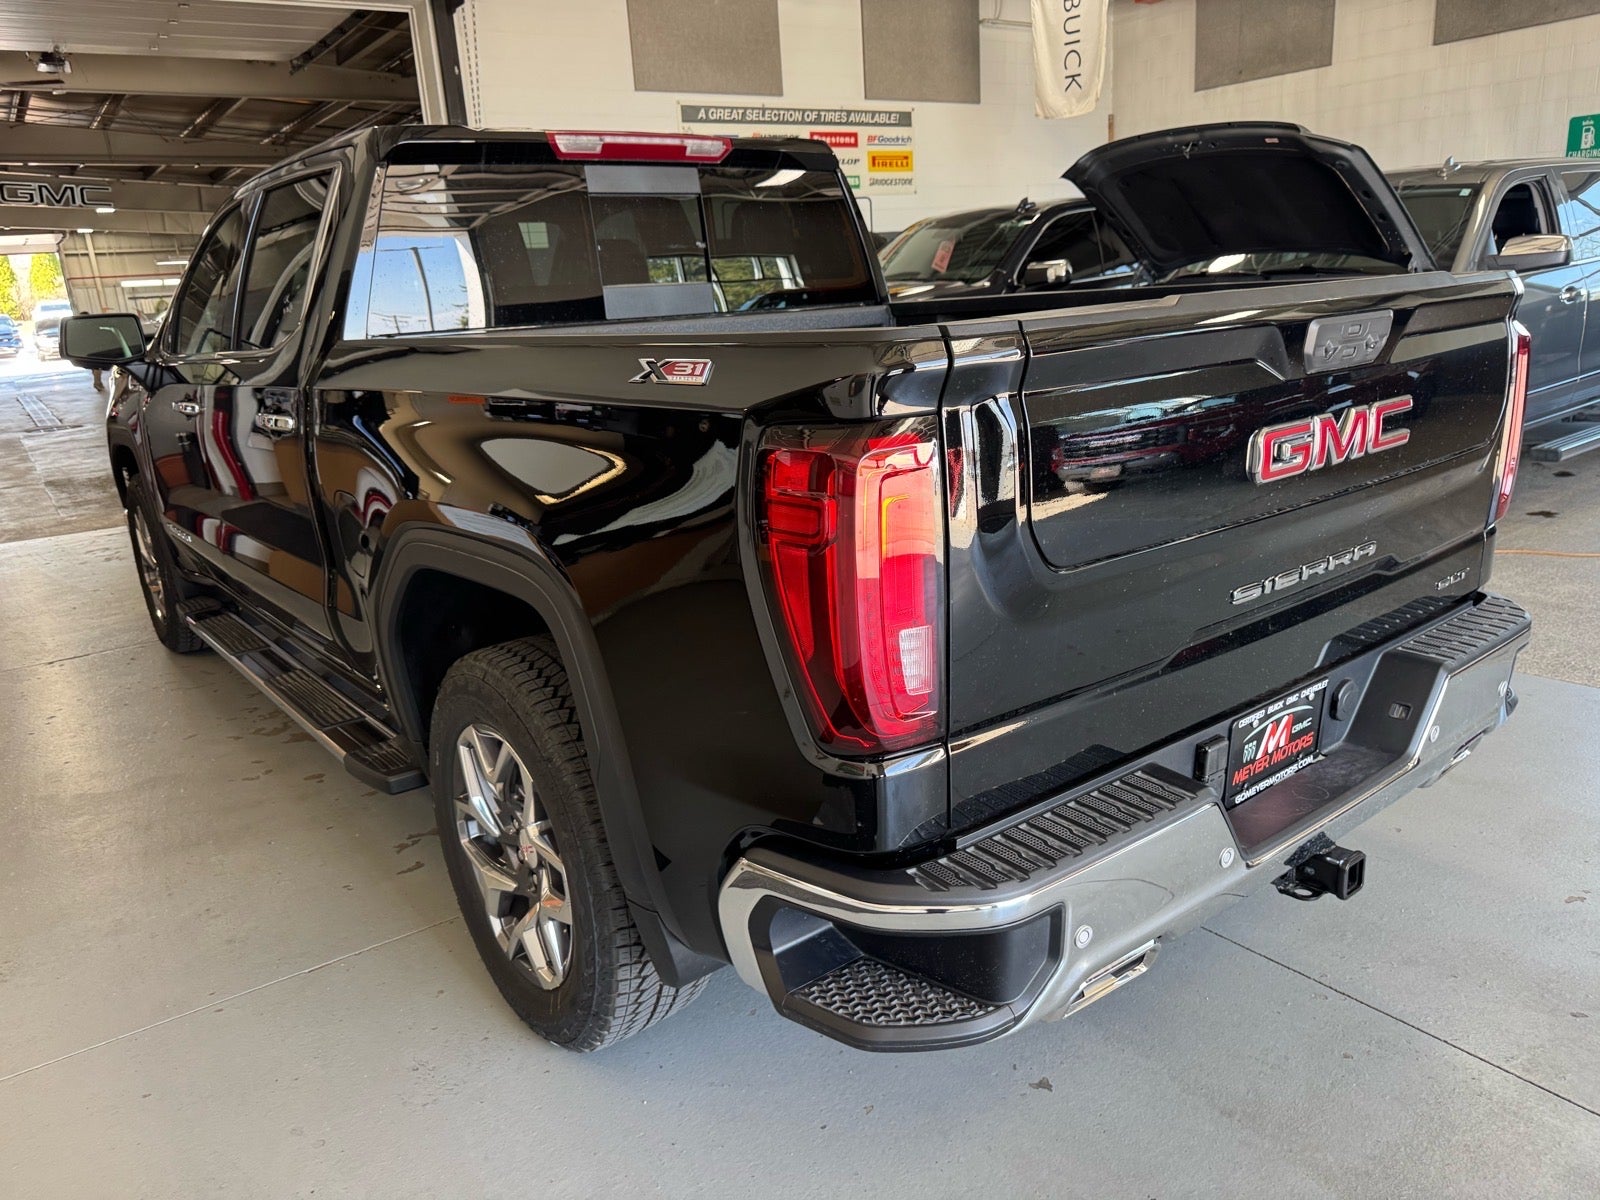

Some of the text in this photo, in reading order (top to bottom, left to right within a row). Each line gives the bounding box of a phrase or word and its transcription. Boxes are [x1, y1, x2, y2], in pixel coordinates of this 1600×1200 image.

[1063, 0, 1082, 92] BUICK
[698, 107, 900, 125] A GREAT SELECTION OF TIRES AVAILABLE!
[866, 134, 912, 145] BFGoodrich
[872, 155, 909, 168] PIRELLI
[0, 181, 114, 208] GMC
[628, 358, 707, 385] X31
[1246, 394, 1413, 485] GMC
[1230, 540, 1377, 604] SIERRA
[1267, 700, 1285, 715] BUICK
[1286, 693, 1300, 706] GMC
[1301, 680, 1329, 698] CHEVROLET
[1292, 717, 1313, 734] GMC
[1232, 731, 1315, 786] MEYER MOTORS
